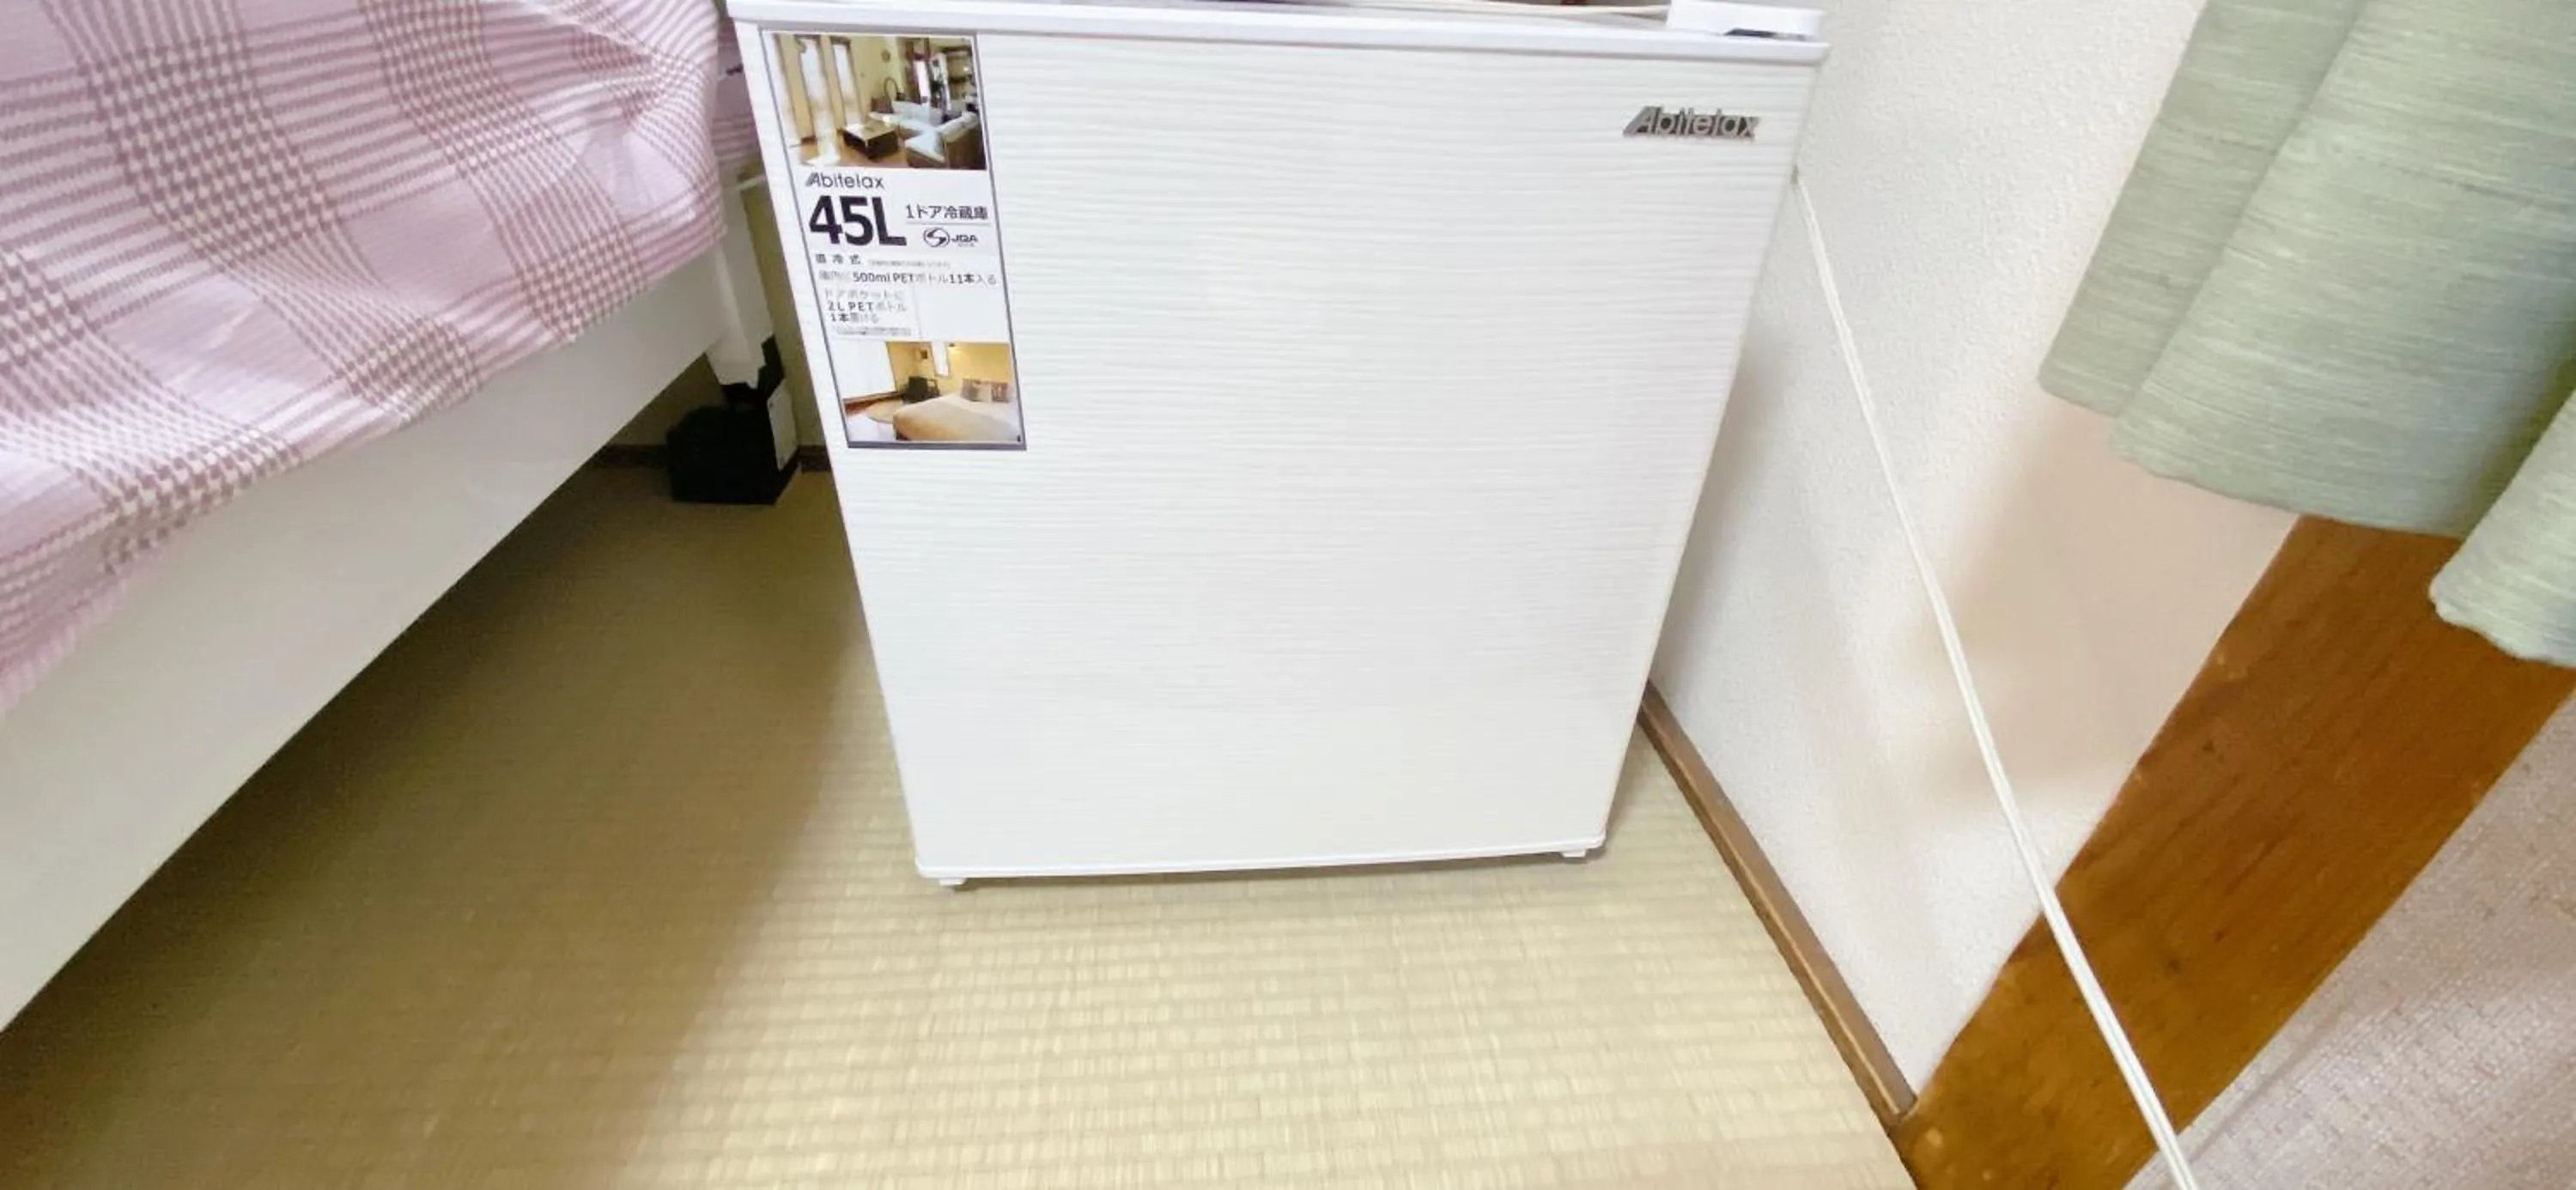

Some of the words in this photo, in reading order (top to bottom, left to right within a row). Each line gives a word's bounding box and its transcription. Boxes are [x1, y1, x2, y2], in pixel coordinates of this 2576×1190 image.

[1622, 106, 1759, 139] Abitelax
[805, 171, 884, 190] Abitelax
[809, 195, 907, 246] 45L
